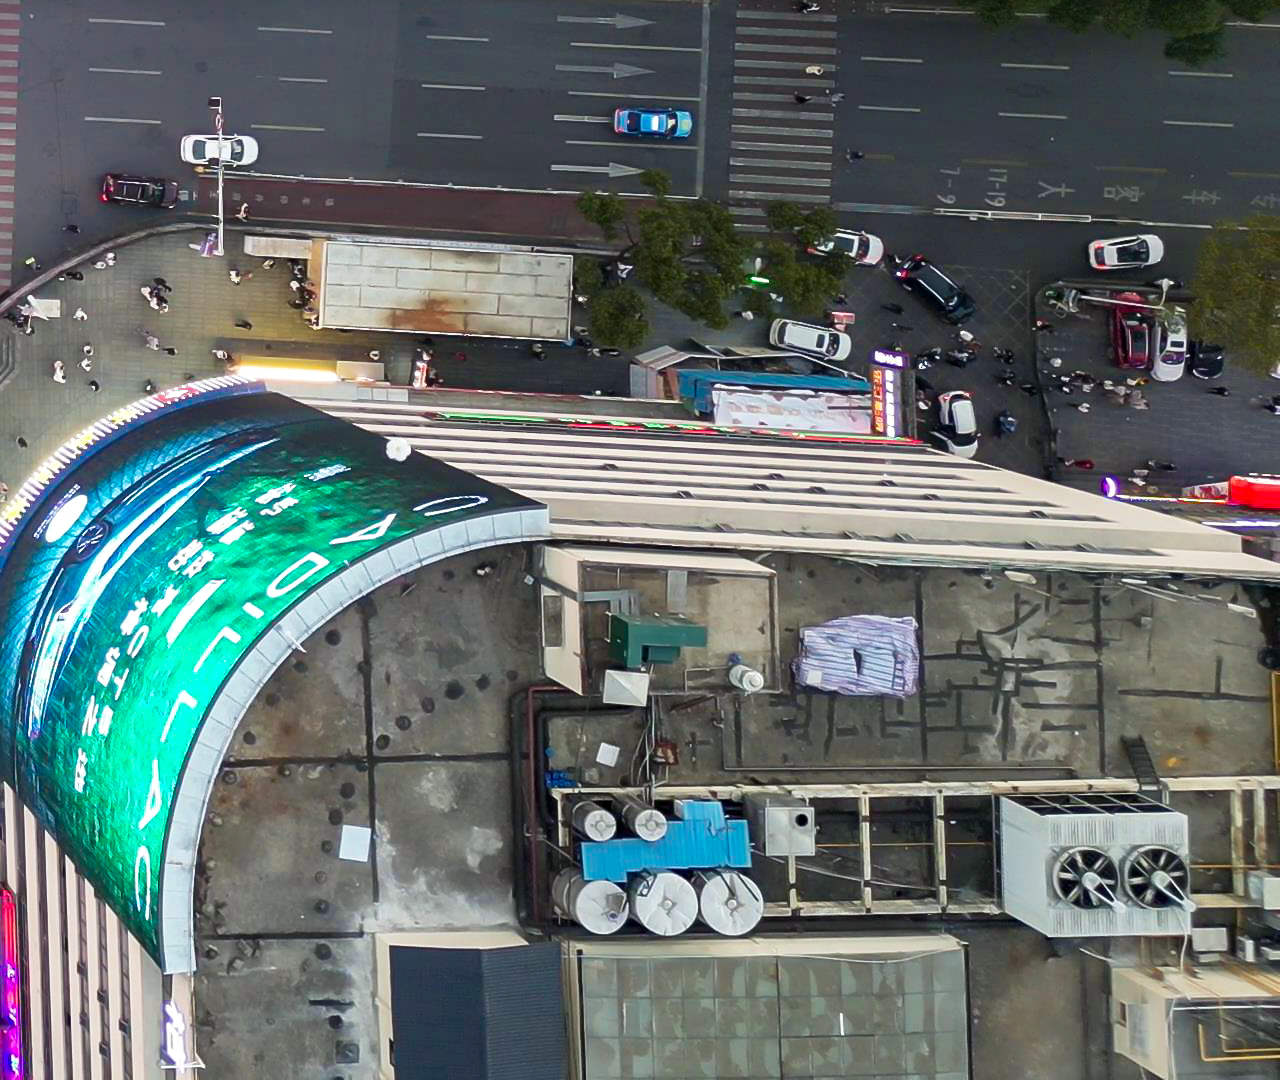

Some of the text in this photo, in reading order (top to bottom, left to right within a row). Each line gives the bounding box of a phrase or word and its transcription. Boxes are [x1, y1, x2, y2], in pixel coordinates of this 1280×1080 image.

[937, 167, 960, 204] 7-9
[985, 168, 1007, 206] 17-19
[135, 495, 489, 920] CADILLAC
